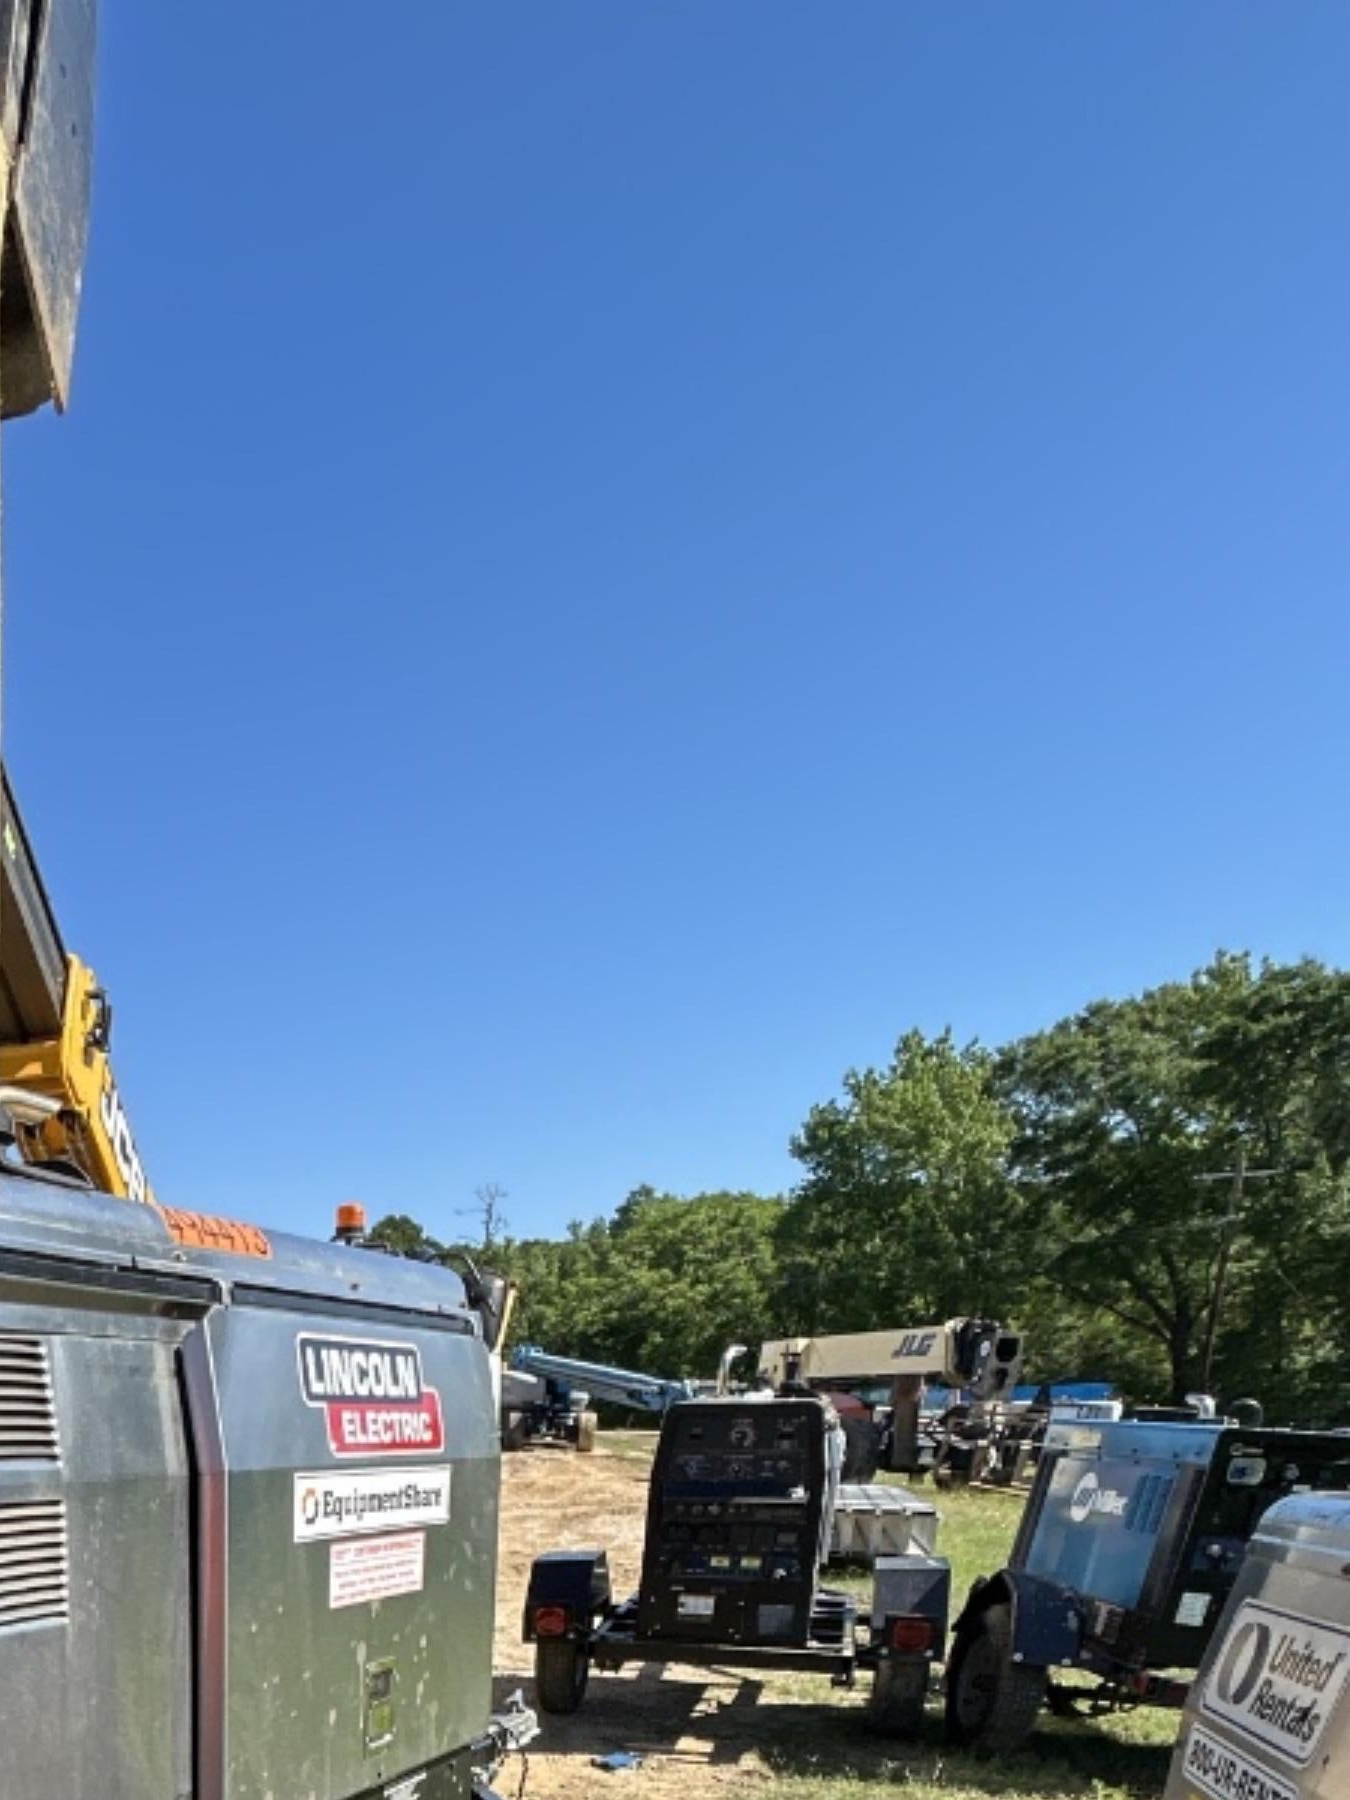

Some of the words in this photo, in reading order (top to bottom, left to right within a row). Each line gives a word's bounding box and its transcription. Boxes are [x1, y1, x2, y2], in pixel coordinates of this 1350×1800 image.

[891, 1332, 937, 1359] JLG
[305, 1346, 419, 1399] LINCOLN
[341, 1409, 434, 1445] ELECTRIC
[322, 1483, 444, 1523] EquipmentShare
[1267, 1634, 1346, 1692] United
[1248, 1676, 1321, 1743] Rentals
